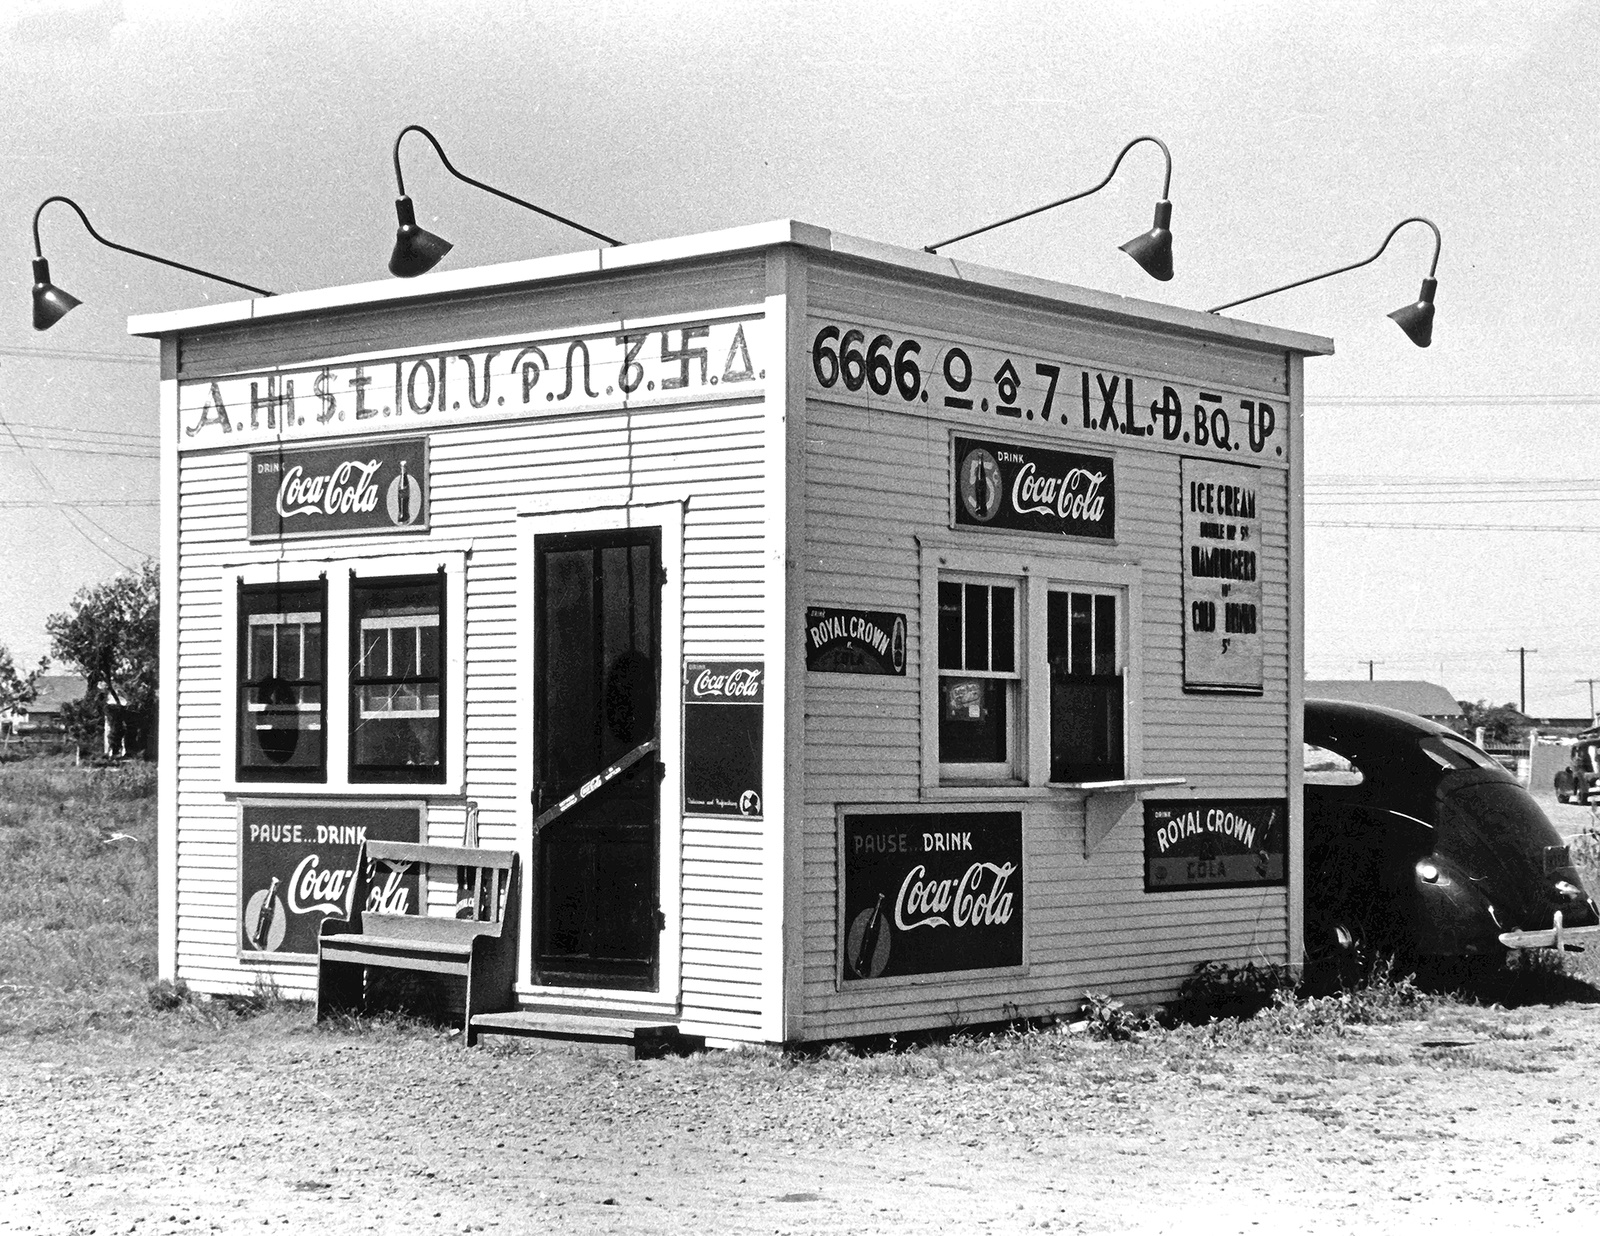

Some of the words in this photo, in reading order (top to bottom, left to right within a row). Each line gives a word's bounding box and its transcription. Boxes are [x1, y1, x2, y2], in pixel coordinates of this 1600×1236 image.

[997, 451, 1025, 464] DRINK
[276, 459, 382, 518] Coca-Cola
[1012, 462, 1107, 522] Coca-Cola
[1190, 481, 1214, 514] ICE
[1216, 483, 1256, 519] CREAM
[810, 616, 848, 648] ROYAL
[849, 616, 890, 656] CROWN
[693, 669, 762, 696] Coca-Cola
[1157, 810, 1203, 853] ROYAL
[1206, 809, 1256, 849] CROWN
[1186, 861, 1227, 880] COLA
[894, 861, 1019, 931] Coca-Cola
